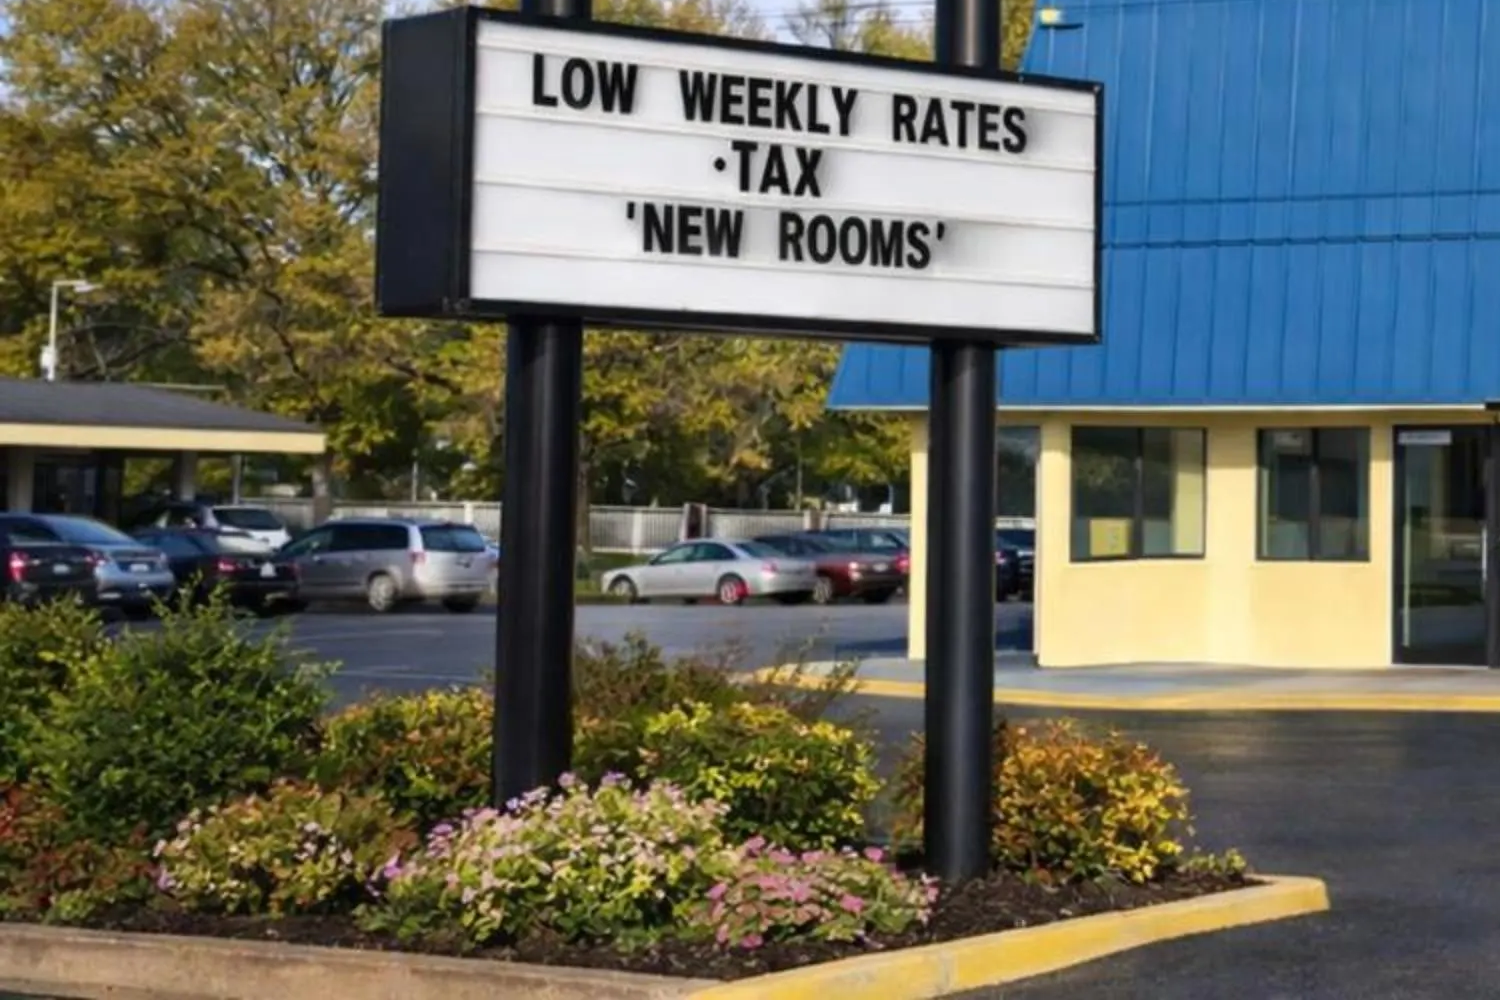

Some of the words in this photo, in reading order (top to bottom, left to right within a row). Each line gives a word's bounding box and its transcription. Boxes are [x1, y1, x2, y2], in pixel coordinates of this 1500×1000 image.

[532, 53, 638, 114] LOW
[679, 69, 858, 137] WEEKLY
[892, 94, 1027, 154] RATES
